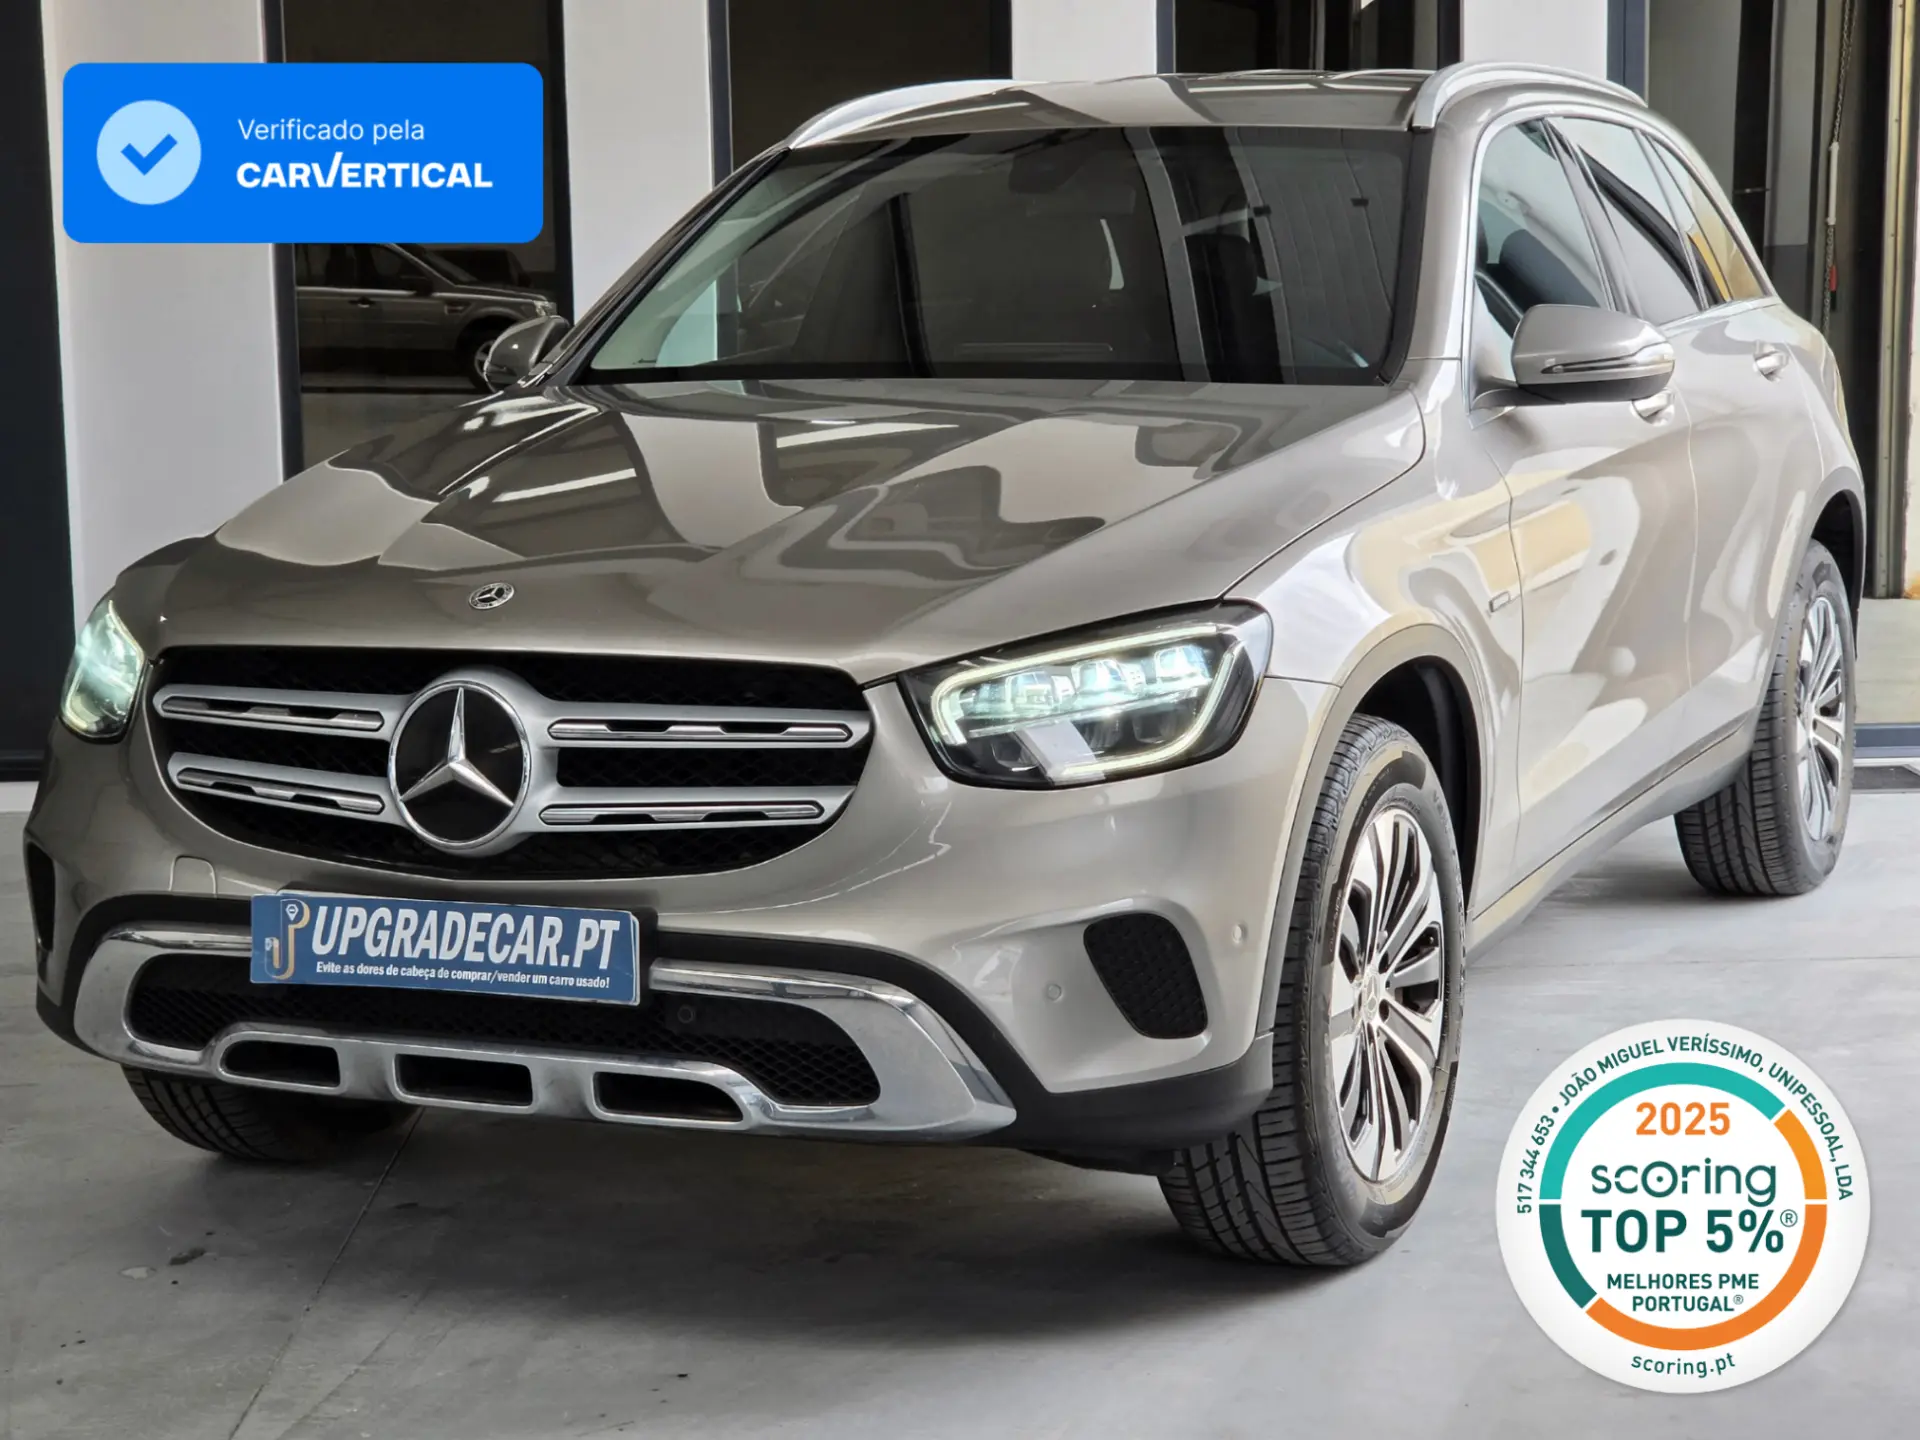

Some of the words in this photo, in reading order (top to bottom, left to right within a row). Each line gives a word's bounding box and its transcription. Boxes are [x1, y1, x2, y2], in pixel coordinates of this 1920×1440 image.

[311, 905, 621, 970] UPGRADECAR.PT
[316, 961, 341, 974] Evite
[343, 963, 355, 974] as
[357, 963, 384, 976] dores
[386, 964, 399, 976] de
[400, 965, 436, 981] cabeça
[437, 967, 450, 979] de
[451, 969, 531, 984] comprar/vender
[532, 975, 547, 984] um
[549, 977, 574, 987] carro
[576, 976, 610, 988] usado!
